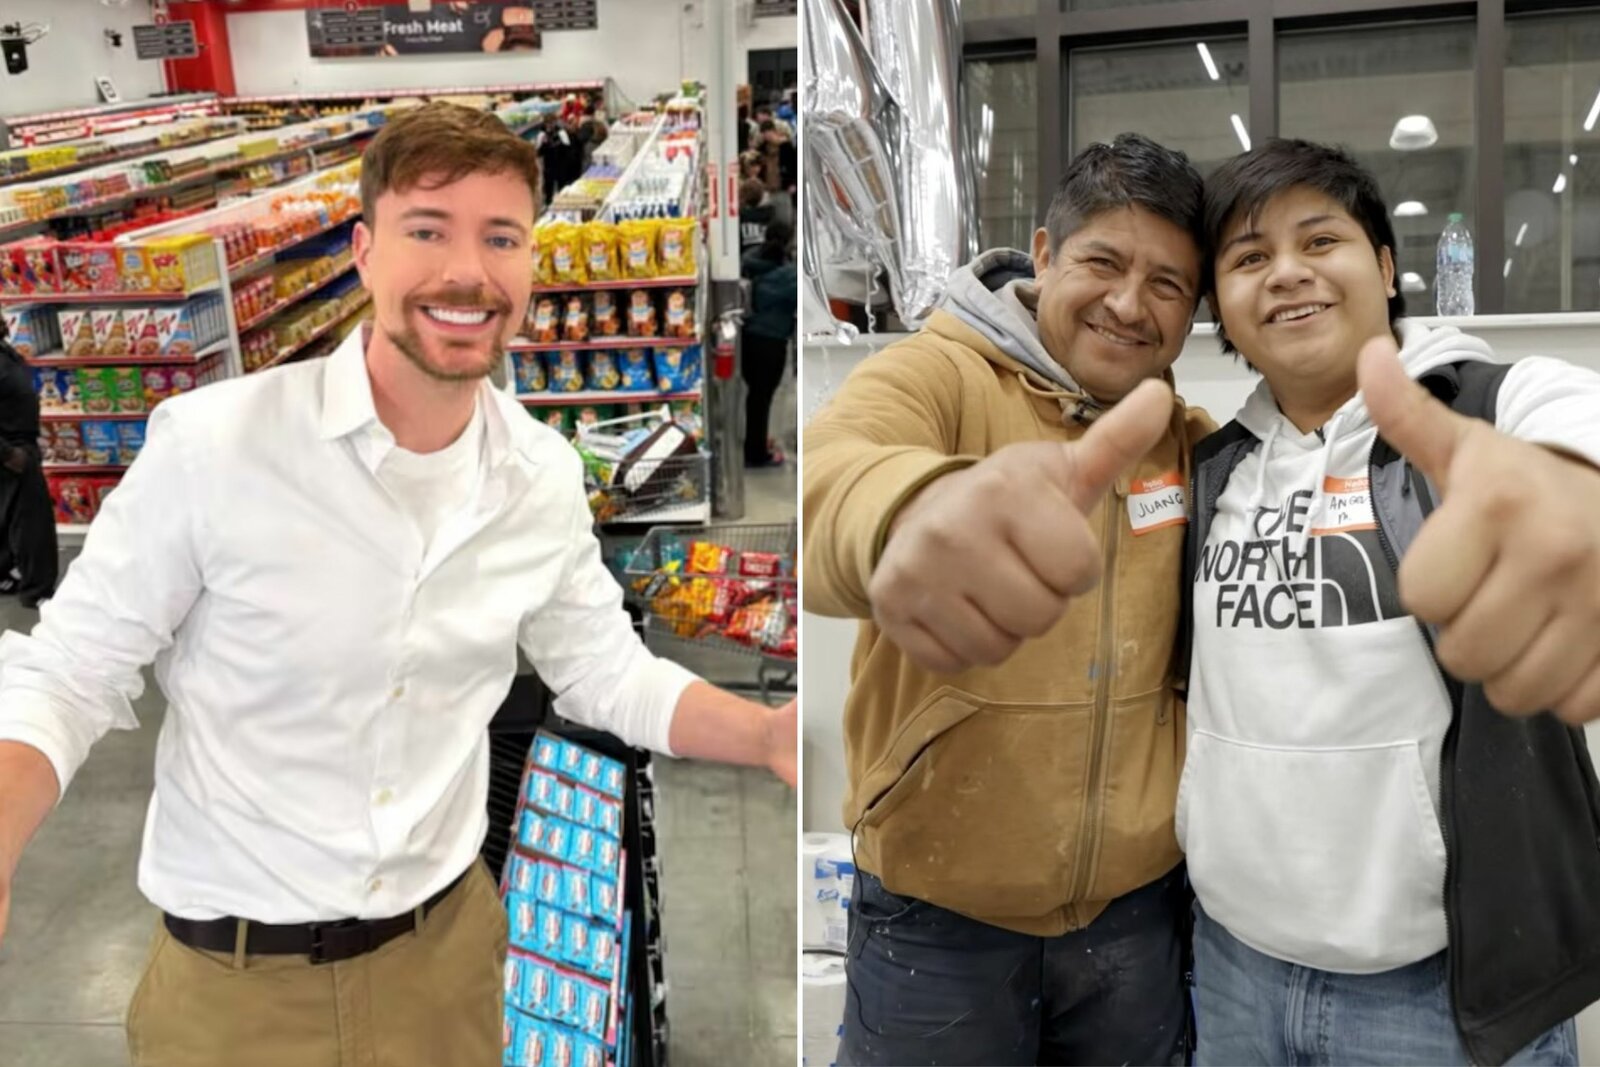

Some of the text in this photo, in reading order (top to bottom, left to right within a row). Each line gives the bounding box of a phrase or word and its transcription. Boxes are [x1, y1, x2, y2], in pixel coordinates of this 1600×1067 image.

[383, 20, 423, 35] Fresh
[426, 18, 463, 33] Meat
[1138, 493, 1183, 518] JUANG
[1194, 536, 1315, 583] NORTH
[1216, 583, 1315, 630] FACE
